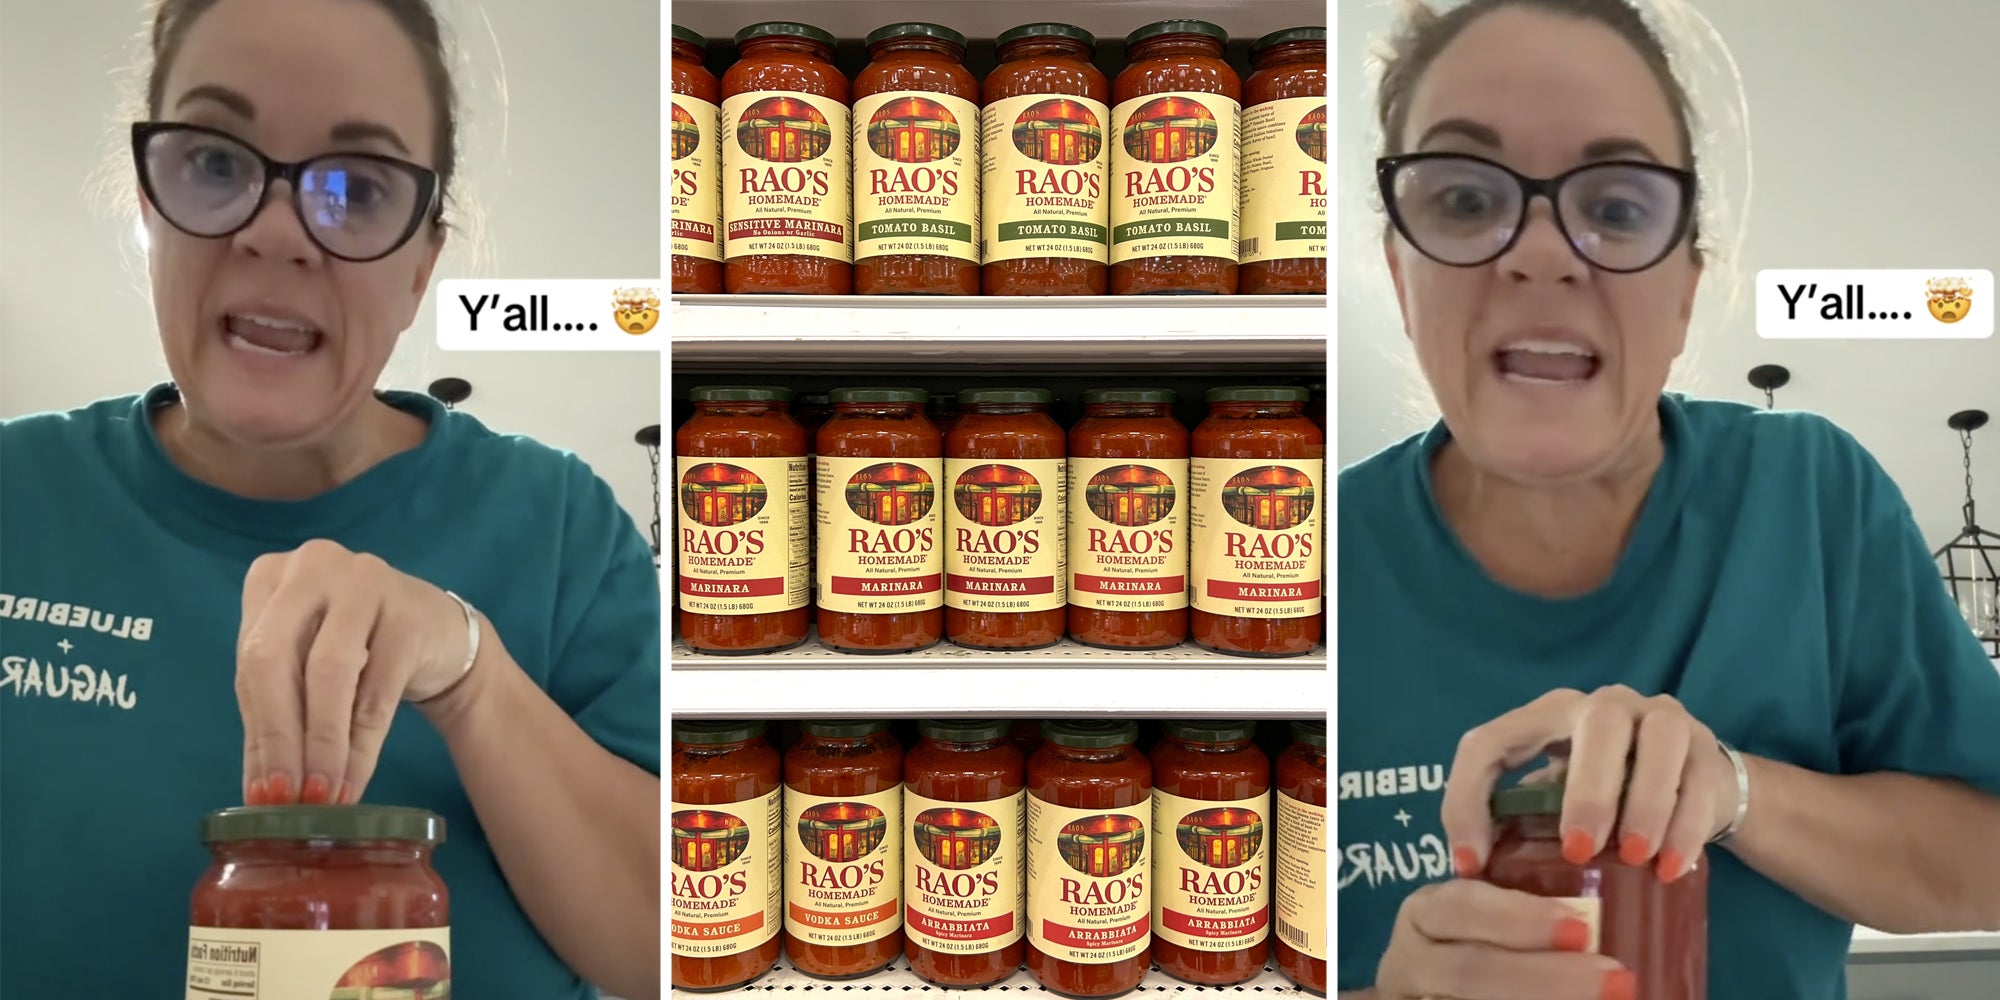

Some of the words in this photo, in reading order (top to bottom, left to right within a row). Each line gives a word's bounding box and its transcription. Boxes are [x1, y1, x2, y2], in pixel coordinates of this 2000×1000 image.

[740, 167, 828, 196] RAO'S
[870, 167, 958, 196] RAO'S
[1016, 168, 1100, 199] RAO'S
[1125, 166, 1214, 198] RAO'S
[748, 195, 820, 206] HOMEMADE
[878, 195, 950, 206] HOMEMADE
[1026, 196, 1094, 210] HOMEMADE
[1133, 195, 1205, 208] HOMEMADE
[730, 220, 781, 232] SENSITIVE
[785, 220, 842, 236] MARINARA
[872, 223, 917, 234] TOMATO
[922, 223, 956, 235] BASIL
[1017, 224, 1066, 235] TOMATO
[1070, 226, 1098, 238] BASIL
[1126, 222, 1171, 237] TOMATO
[1176, 222, 1212, 232] BASIL
[1180, 242, 1189, 250] LB)
[683, 528, 764, 555] RAO'S
[848, 528, 933, 553] RAO'S
[956, 528, 1039, 554] RAO'S
[1088, 528, 1172, 554] RAO'S
[1224, 532, 1312, 558] RAO'S
[688, 556, 754, 566] HOMEMADE
[858, 554, 927, 564] HOMEMADE
[963, 555, 1030, 565] HOMEMADE
[1096, 555, 1165, 564] HOMEMADE
[1234, 560, 1306, 570] HOMEMADE
[690, 582, 750, 592] MARINARA
[861, 582, 923, 592] MARINARA
[966, 581, 1026, 591] MARINARA
[1100, 580, 1162, 590] MARINARA
[1238, 587, 1302, 597] MARINARA
[800, 859, 884, 888] RAO'S
[1179, 865, 1262, 894] RAO'S
[915, 864, 998, 898] RAO'S
[808, 888, 876, 900] HOMEMADE
[1060, 872, 1143, 904] RAO'S
[922, 894, 989, 908] HOMEMADE
[1189, 894, 1255, 906] HOMEMADE
[936, 908, 956, 916] Natural,
[1070, 902, 1137, 916] HOMEMADE
[1228, 906, 1250, 914] Premium
[804, 913, 840, 925] VODKA
[844, 912, 880, 925] SAUCE
[921, 918, 990, 932] ARRABBIATA
[1110, 915, 1131, 924] Premium
[1188, 916, 1256, 930] ARRABBIATA
[703, 923, 741, 936] SAUCE
[936, 930, 948, 938] Spicy
[1068, 925, 1137, 940] ARRABBIATA
[931, 940, 938, 948] WT
